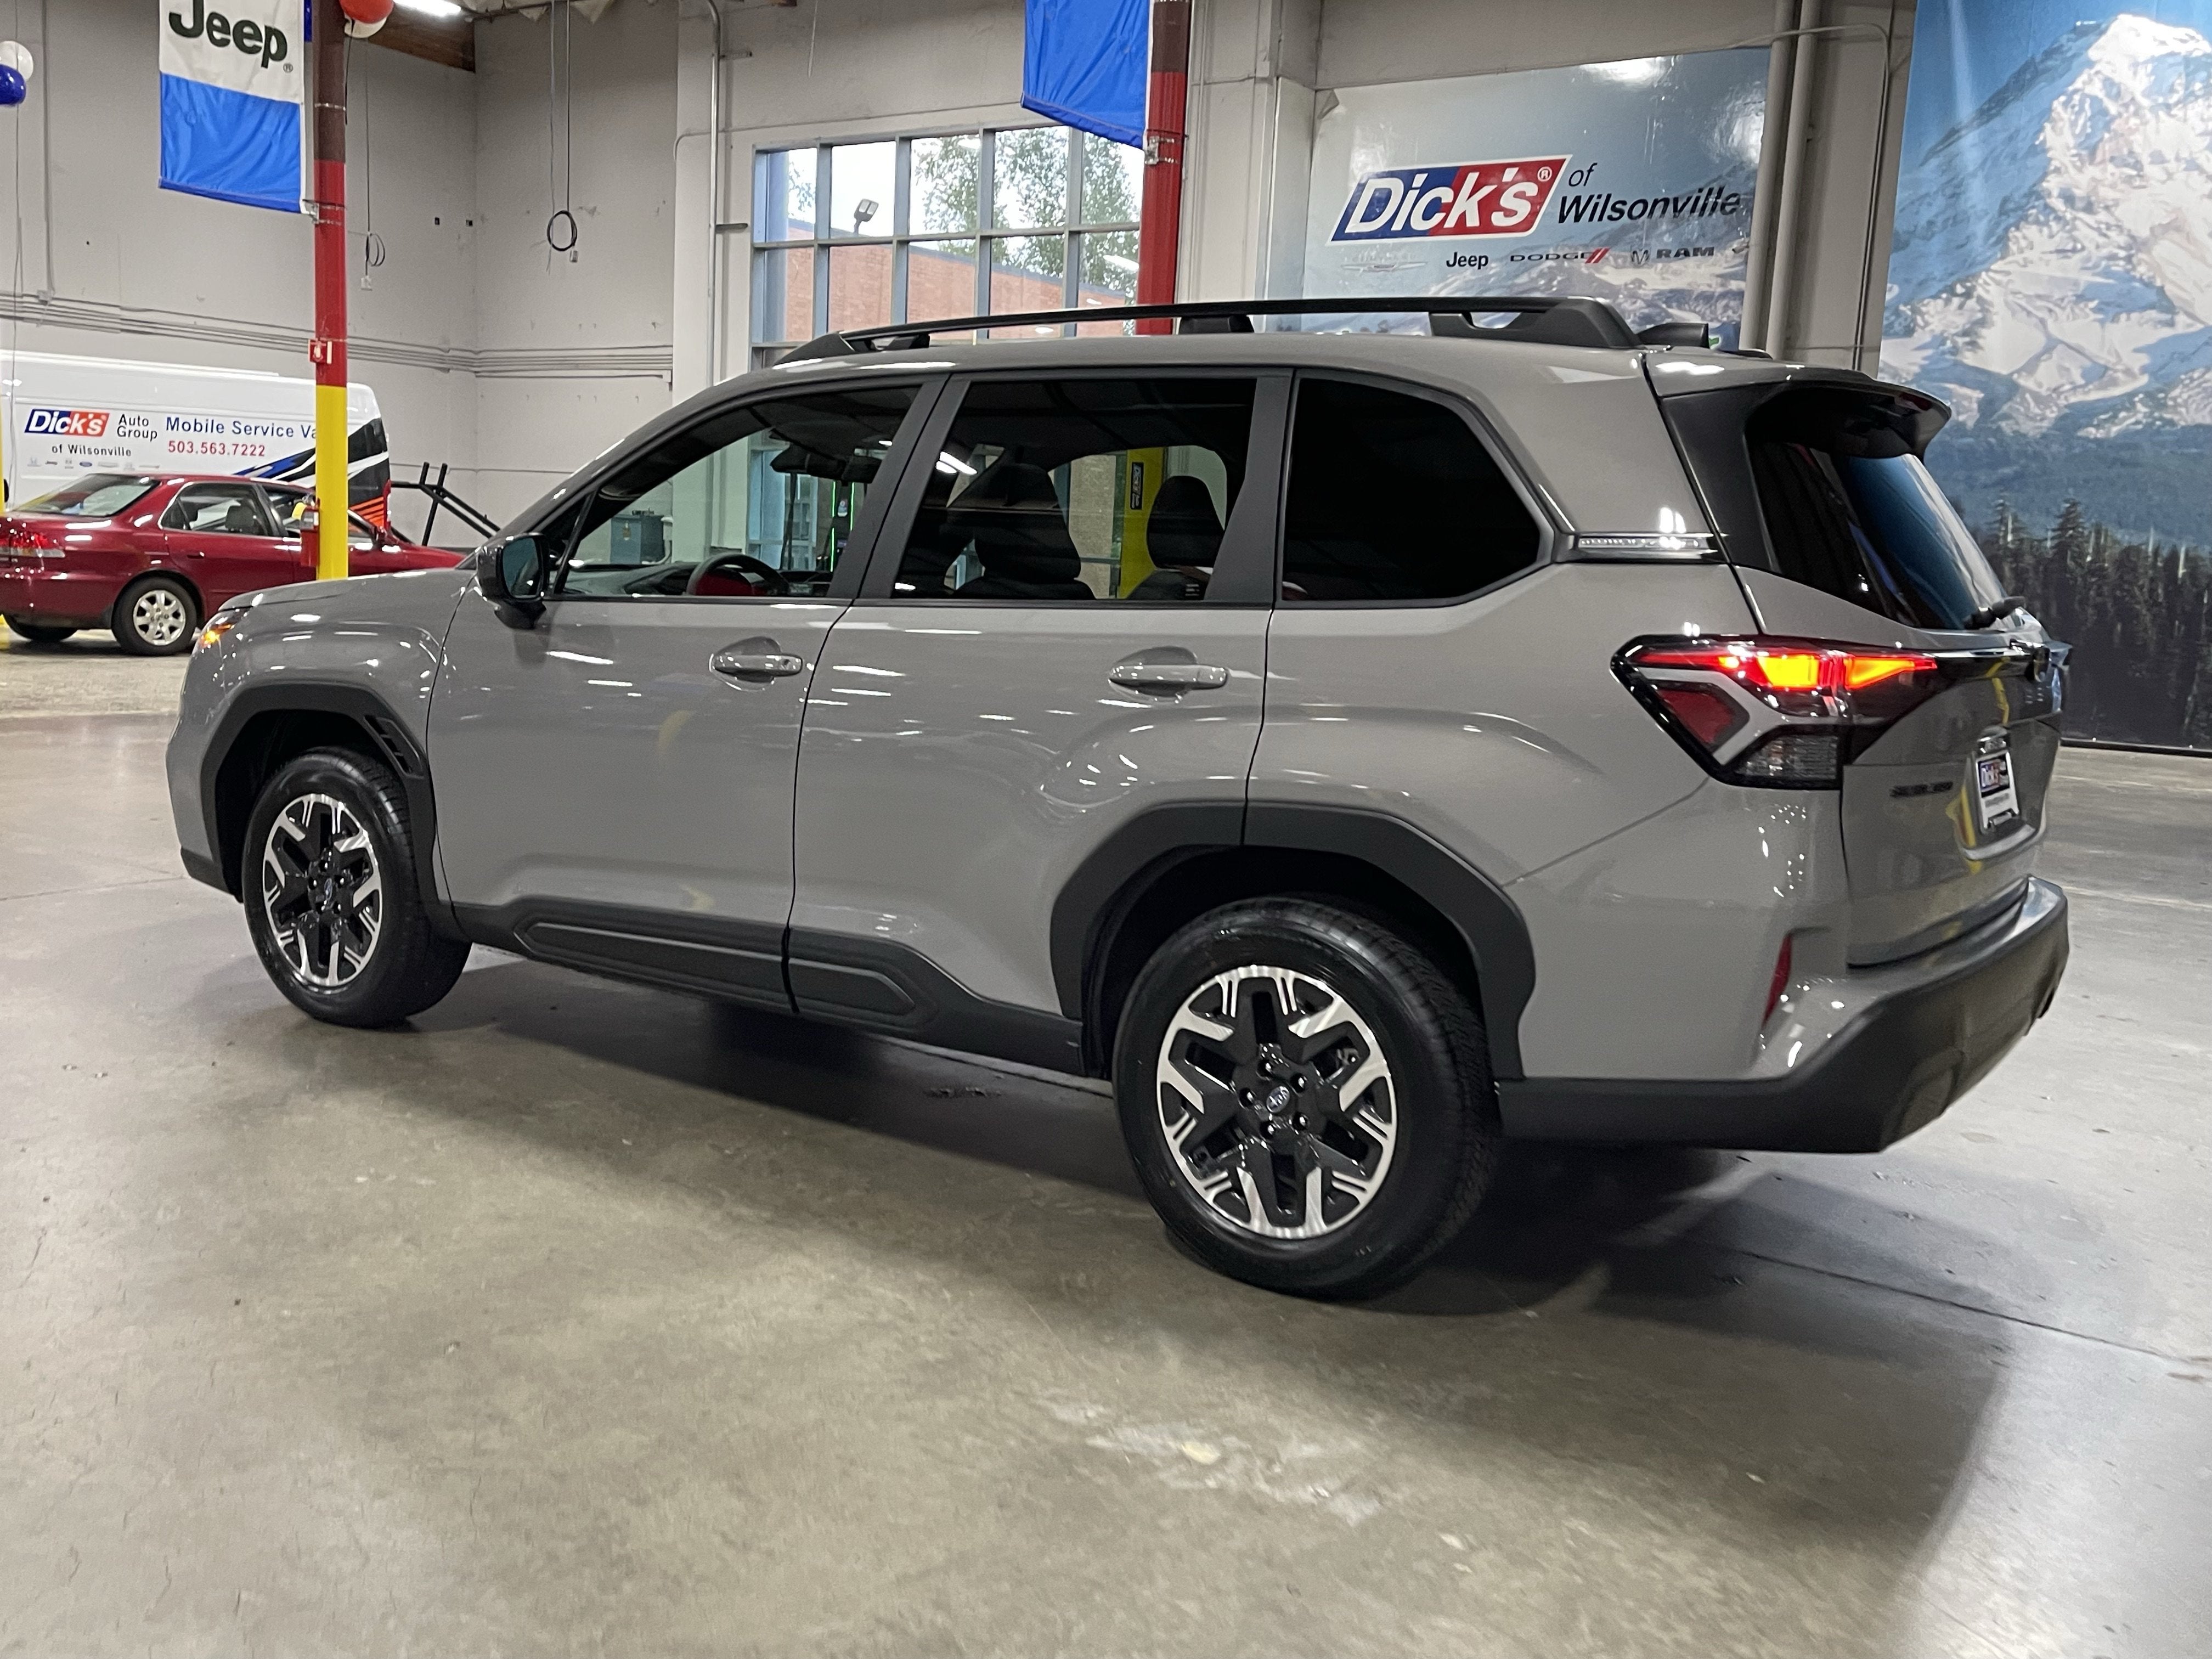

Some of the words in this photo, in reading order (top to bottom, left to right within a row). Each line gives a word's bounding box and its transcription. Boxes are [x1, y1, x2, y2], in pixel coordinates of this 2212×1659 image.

[169, 0, 287, 69] Jeep
[1568, 162, 1598, 187] of
[1344, 167, 1539, 234] Dick's
[1558, 185, 1741, 224] Wilsonville
[1446, 251, 1489, 270] Jeep
[1656, 247, 1715, 259] RAM
[29, 411, 104, 435] Dick's
[119, 414, 149, 427] Auto
[166, 417, 225, 434] Mobile
[232, 420, 294, 437] Service
[301, 425, 317, 439] Va
[117, 426, 157, 442] Group
[52, 444, 63, 454] of
[68, 444, 132, 456] Wilsonville
[168, 441, 266, 456] 503.563.7222
